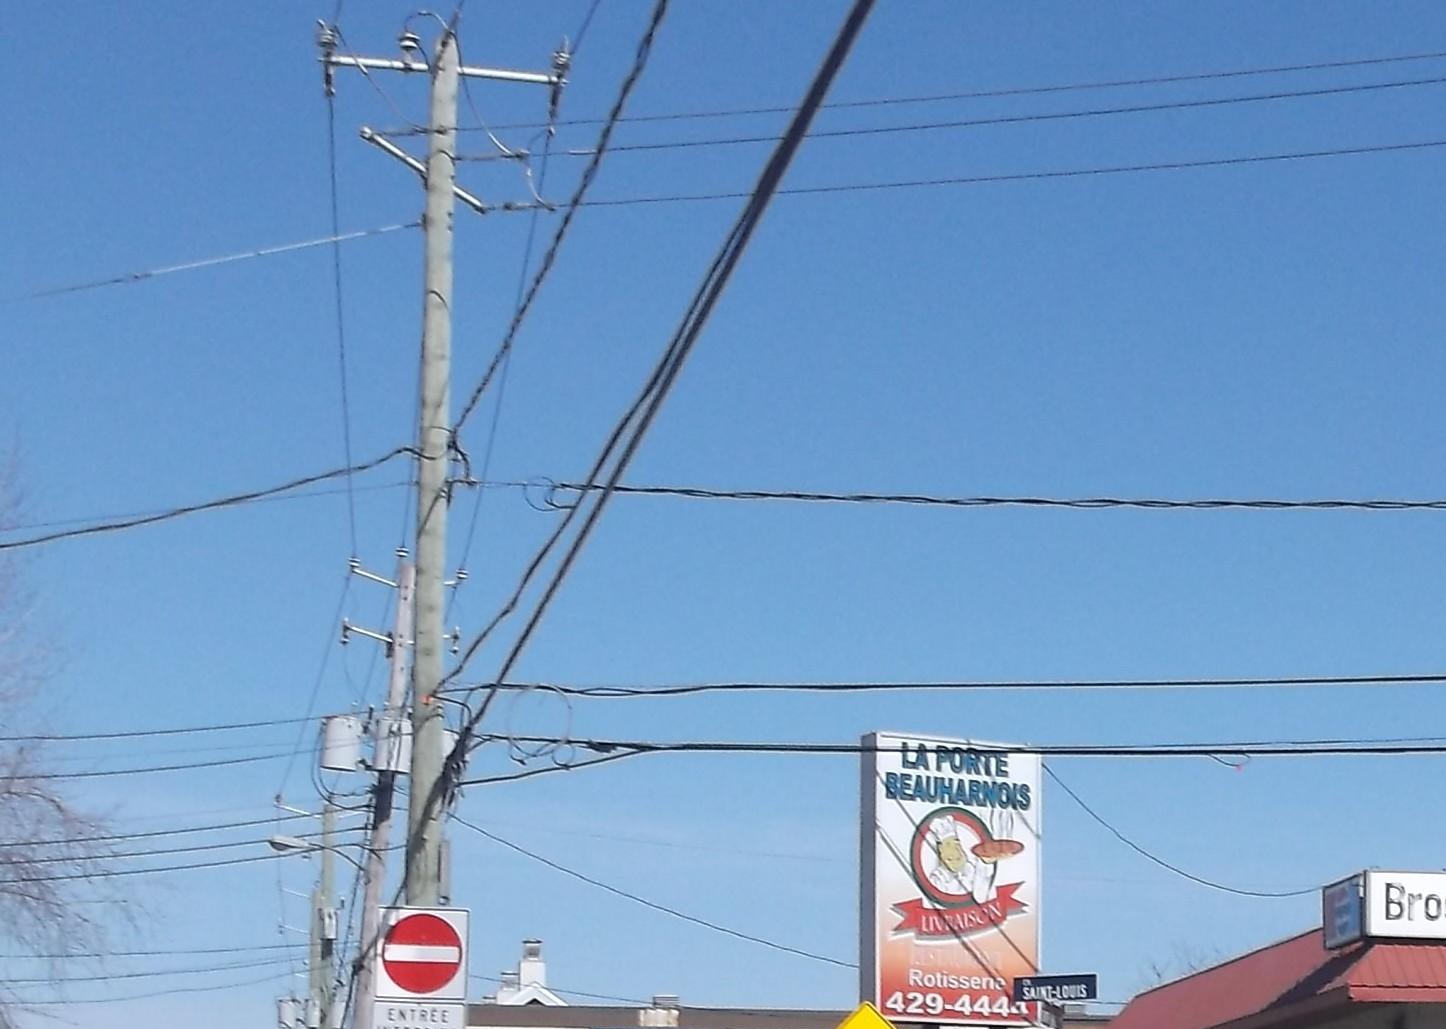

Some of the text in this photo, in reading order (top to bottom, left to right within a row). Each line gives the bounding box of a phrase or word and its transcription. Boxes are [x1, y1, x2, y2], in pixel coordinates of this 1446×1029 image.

[902, 742, 1008, 777] LA PORTE
[886, 772, 1031, 810] BEAUHARNOIS
[1022, 984, 1088, 1000] SAINT-LOUIS
[388, 1007, 449, 1024] ENTRÉE
